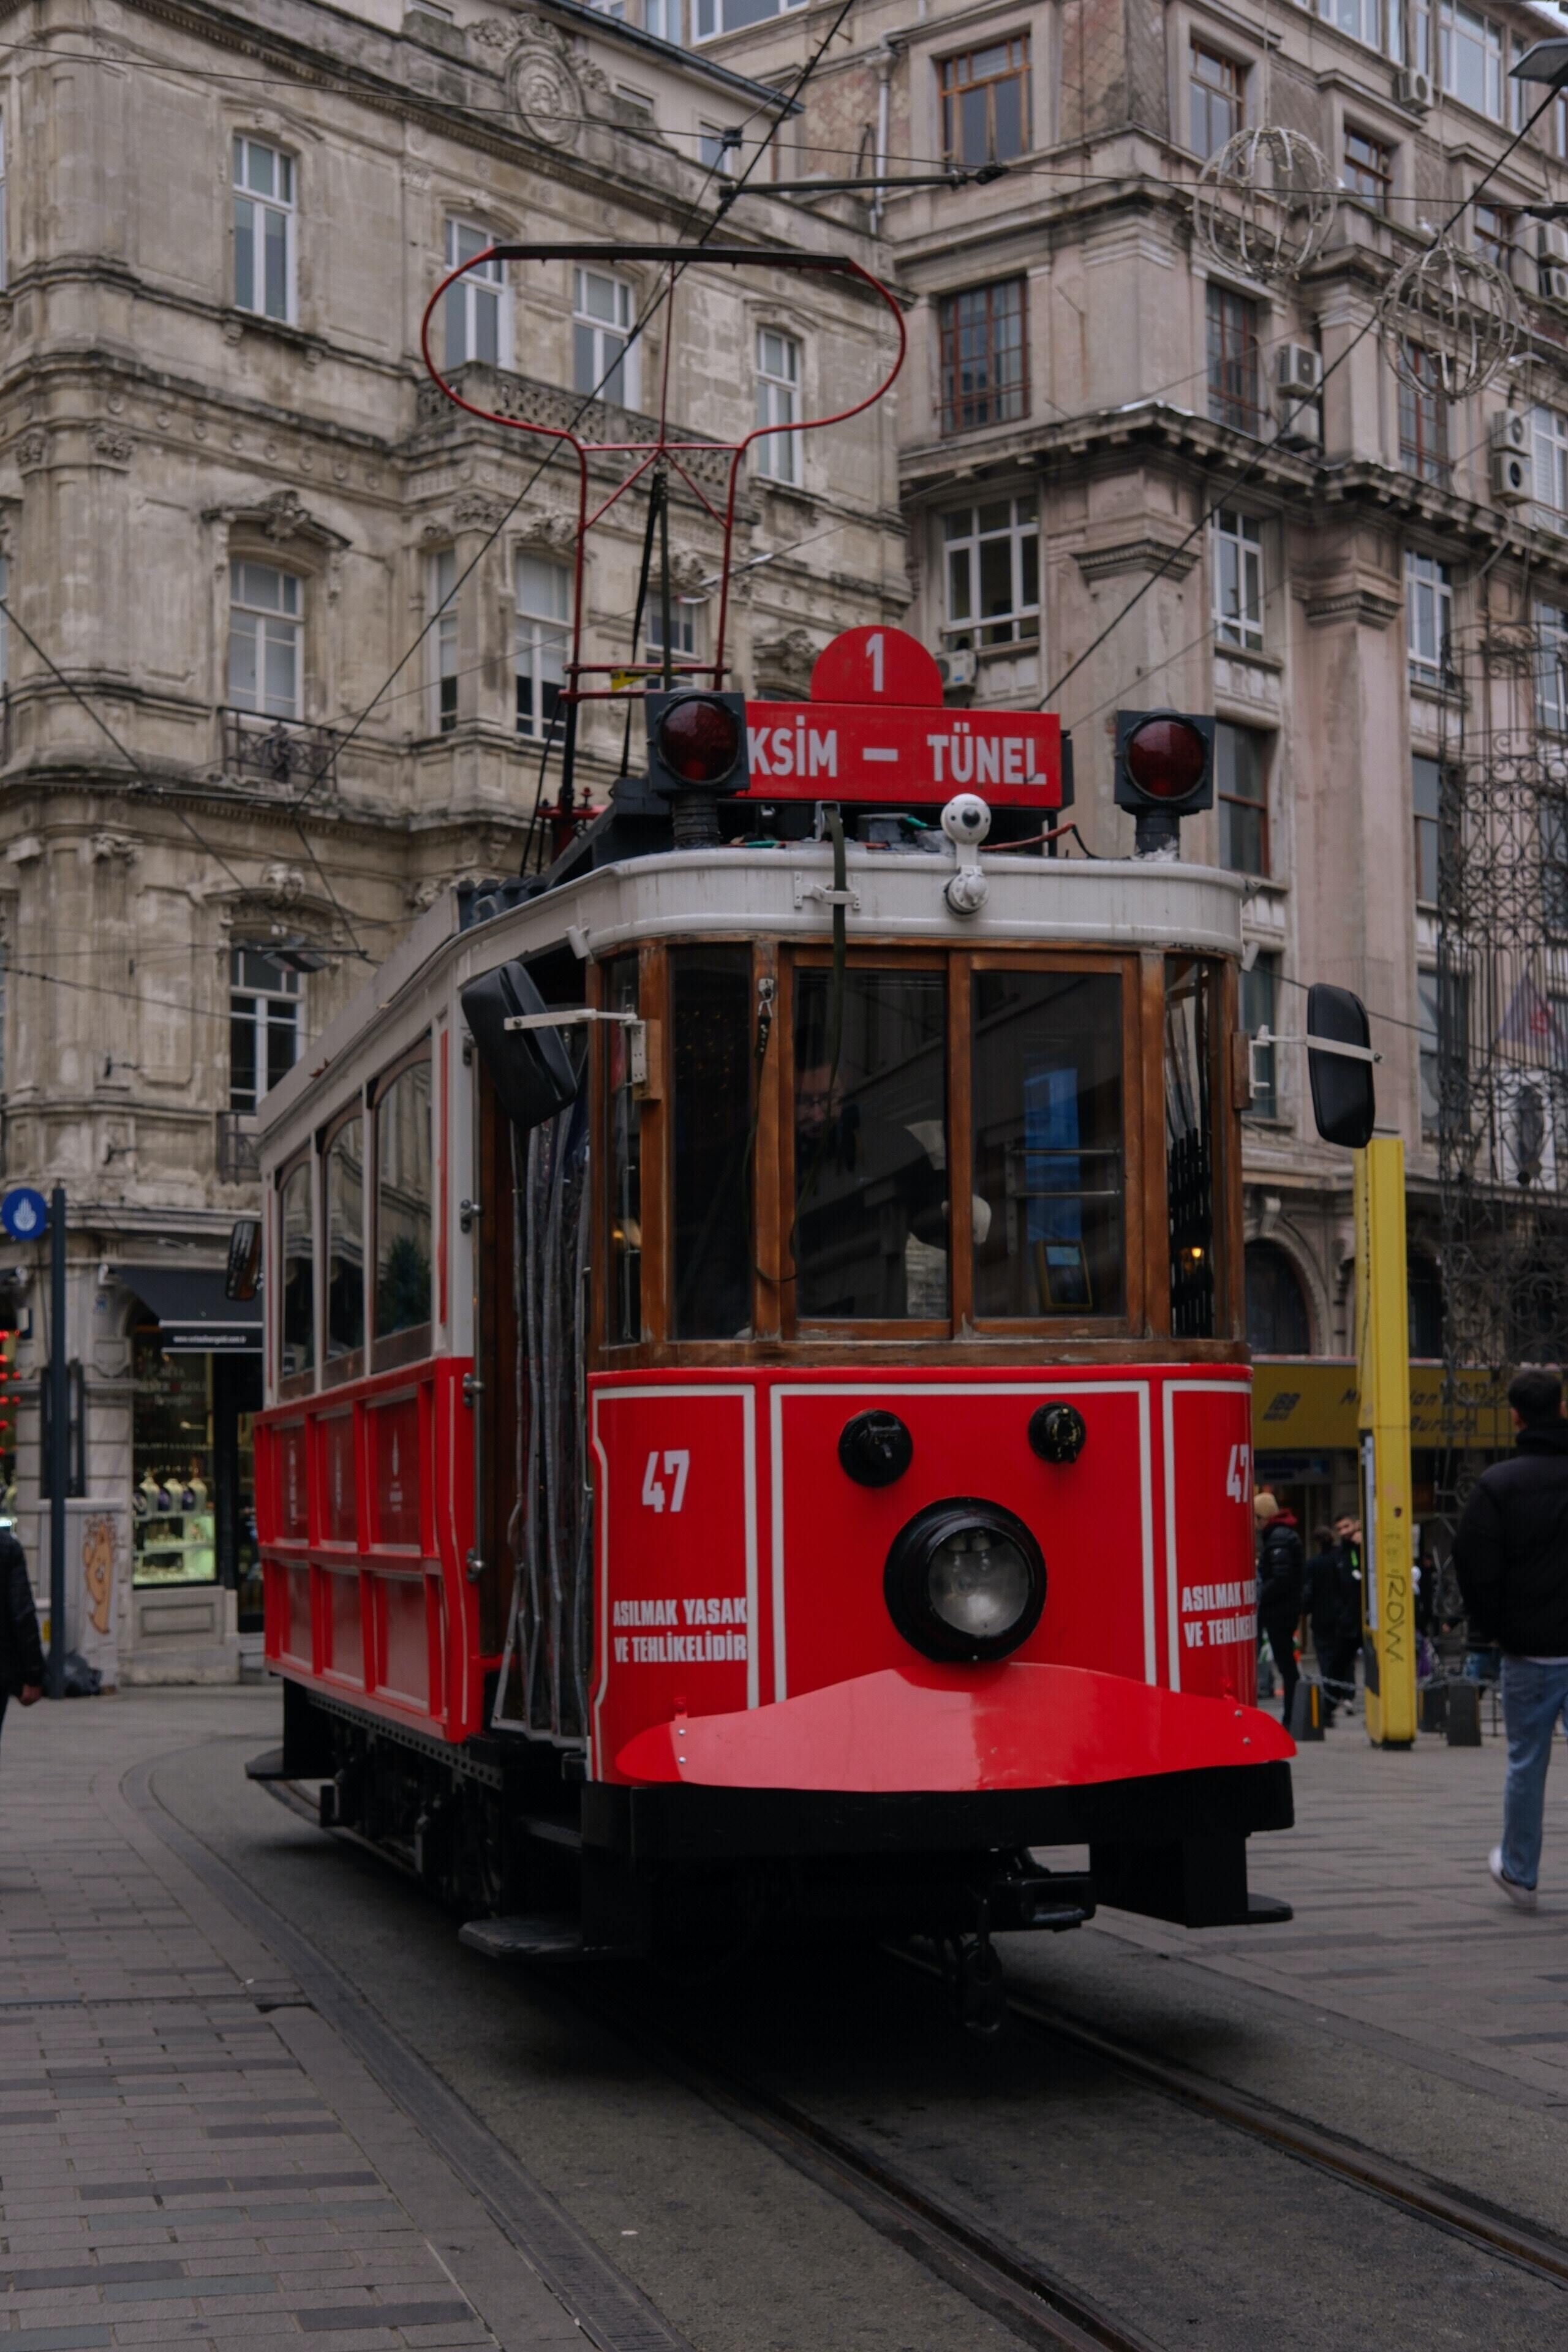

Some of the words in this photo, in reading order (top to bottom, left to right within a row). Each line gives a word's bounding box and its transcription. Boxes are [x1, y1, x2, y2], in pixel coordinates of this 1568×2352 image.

[865, 633, 884, 693] 1
[927, 722, 1047, 785] TÜNEL
[642, 1449, 690, 1513] 47
[1226, 1444, 1250, 1503] 47
[613, 1599, 679, 1626] ASILMAK
[682, 1597, 747, 1625] YASAK
[1182, 1581, 1242, 1612] ASILMAK
[614, 1636, 629, 1663] VE
[631, 1629, 747, 1662] TEHLİKELİDİR
[1183, 1621, 1204, 1648] VE
